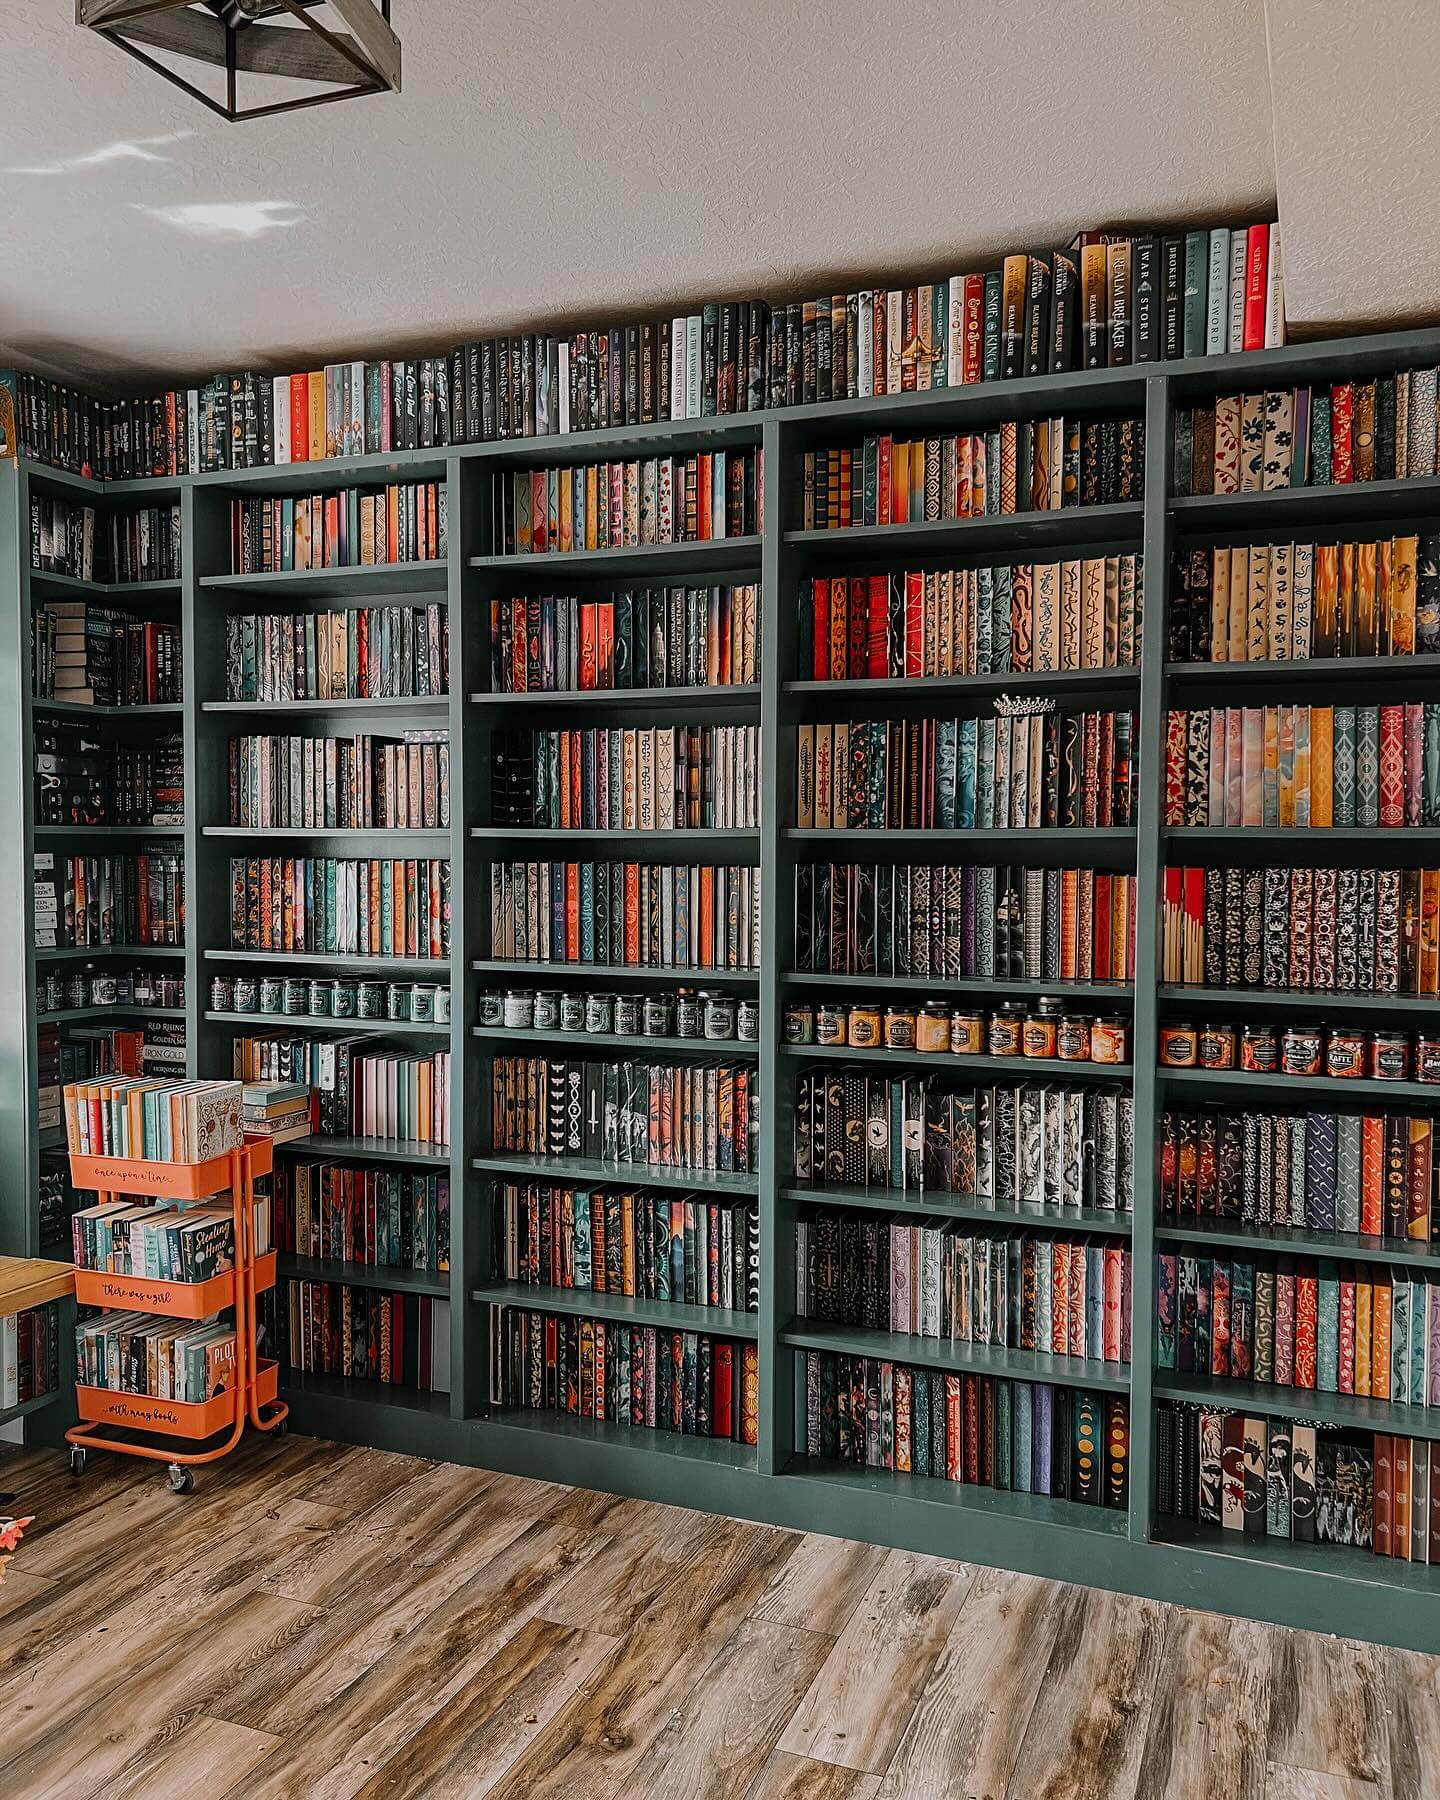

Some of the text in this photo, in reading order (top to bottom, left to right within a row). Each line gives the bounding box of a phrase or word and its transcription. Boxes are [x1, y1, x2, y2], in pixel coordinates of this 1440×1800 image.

[1252, 247, 1263, 292] RED QUEEN
[1112, 257, 1126, 349] REALM BREAKER
[1140, 251, 1149, 341] WAR STORM
[1168, 247, 1177, 350] BROKEN THRONE
[1211, 241, 1222, 344] GLASS SWORD
[1232, 247, 1244, 343] RED QUEEN
[1007, 304, 1016, 327] REALM
[1089, 294, 1097, 347] REALM BREAKER
[987, 333, 998, 363] KING
[406, 398, 415, 417] Dead
[148, 1022, 185, 1032] RED RISING
[152, 1036, 176, 1045] GOLDEN
[145, 1048, 185, 1059] IRON GOLD
[117, 1170, 139, 1182] upon
[195, 1221, 231, 1251] Stealing
[205, 1238, 227, 1259] Home
[102, 1283, 128, 1297] there
[128, 1289, 145, 1301] was
[152, 1292, 172, 1305] girl
[214, 1340, 236, 1365] PLOT
[130, 1408, 153, 1421] many
[153, 1408, 179, 1424] books
